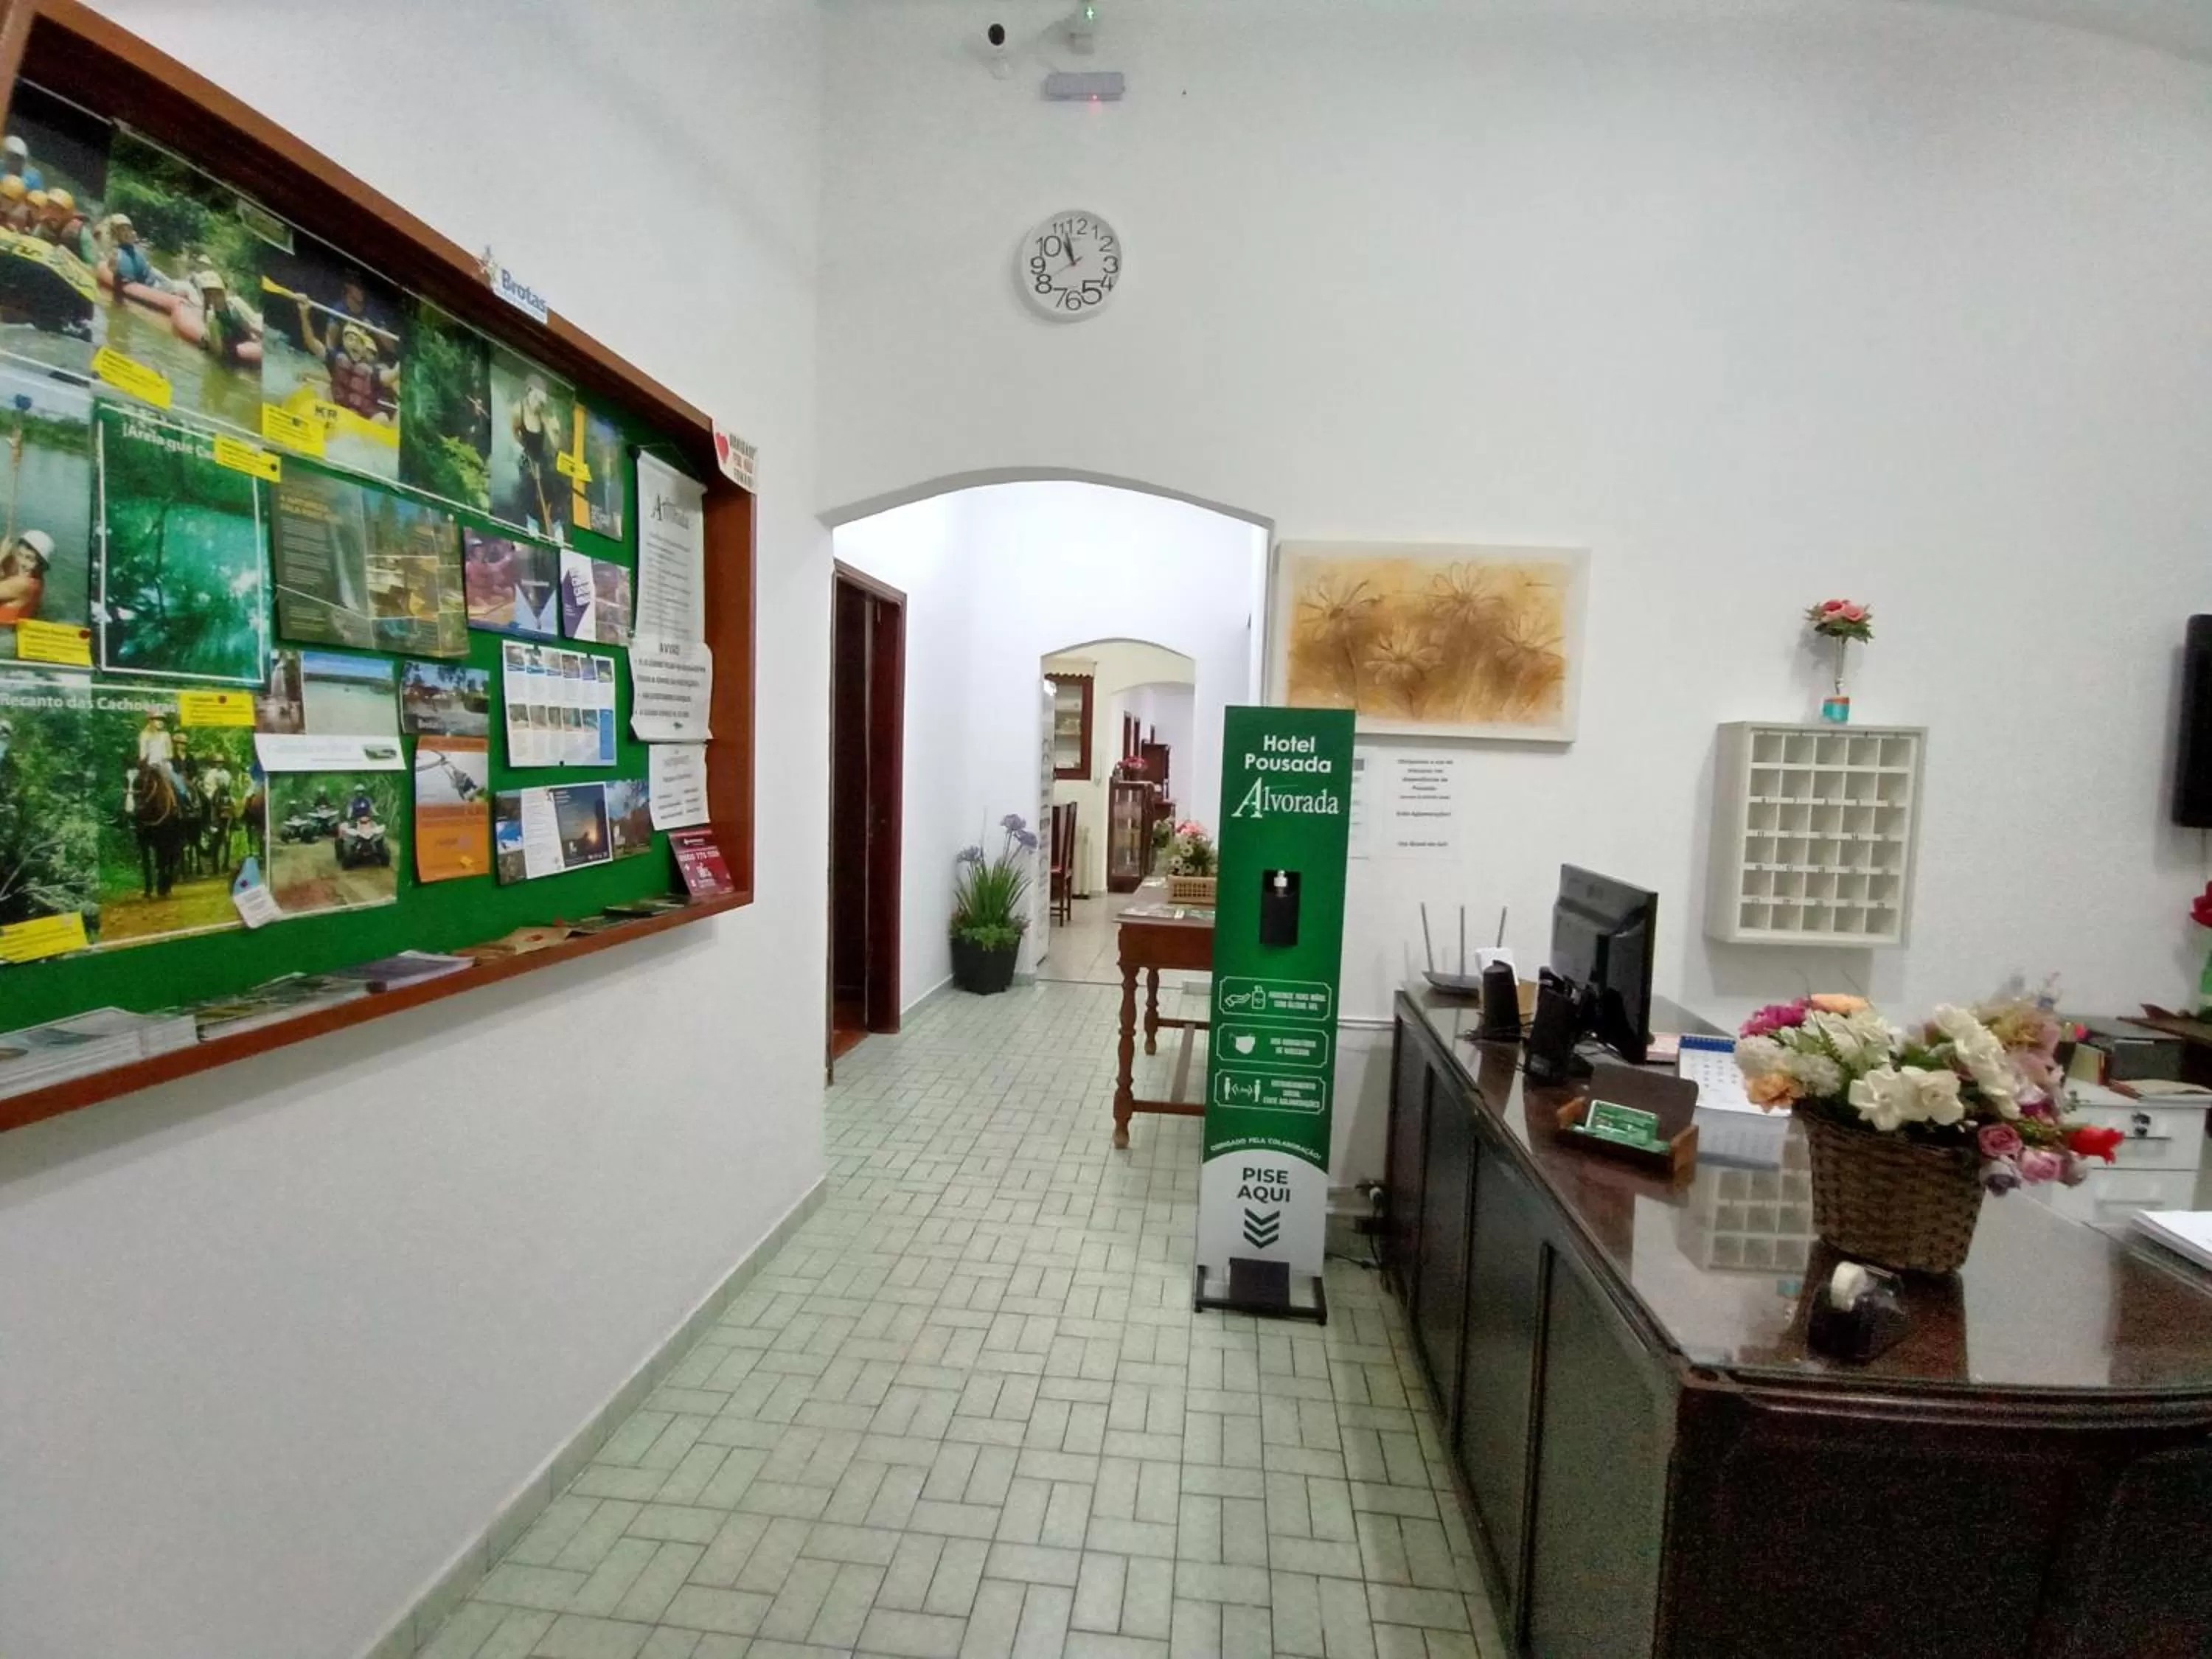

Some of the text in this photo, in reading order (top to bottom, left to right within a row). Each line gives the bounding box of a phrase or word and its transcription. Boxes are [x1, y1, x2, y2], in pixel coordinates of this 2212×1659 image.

[1052, 222, 1065, 234] 11
[1066, 218, 1088, 235] 12
[1091, 224, 1099, 240] 1
[1035, 234, 1062, 257] 10
[1099, 235, 1113, 252] 2
[1030, 256, 1046, 275] 9
[1102, 255, 1119, 274] 3
[501, 268, 546, 313] Brotas
[1034, 274, 1052, 294] 8
[1081, 279, 1103, 305] 5
[1100, 274, 1113, 292] 4
[1053, 287, 1068, 308] 7
[1065, 290, 1082, 311] 6
[0, 692, 63, 708] Recanto
[66, 694, 94, 709] das
[1263, 734, 1316, 754] Hotel
[1244, 752, 1332, 773] Pousada
[1231, 776, 1340, 819] Alvorada
[1242, 1166, 1289, 1185] PISE
[1236, 1184, 1291, 1204] AQUI
